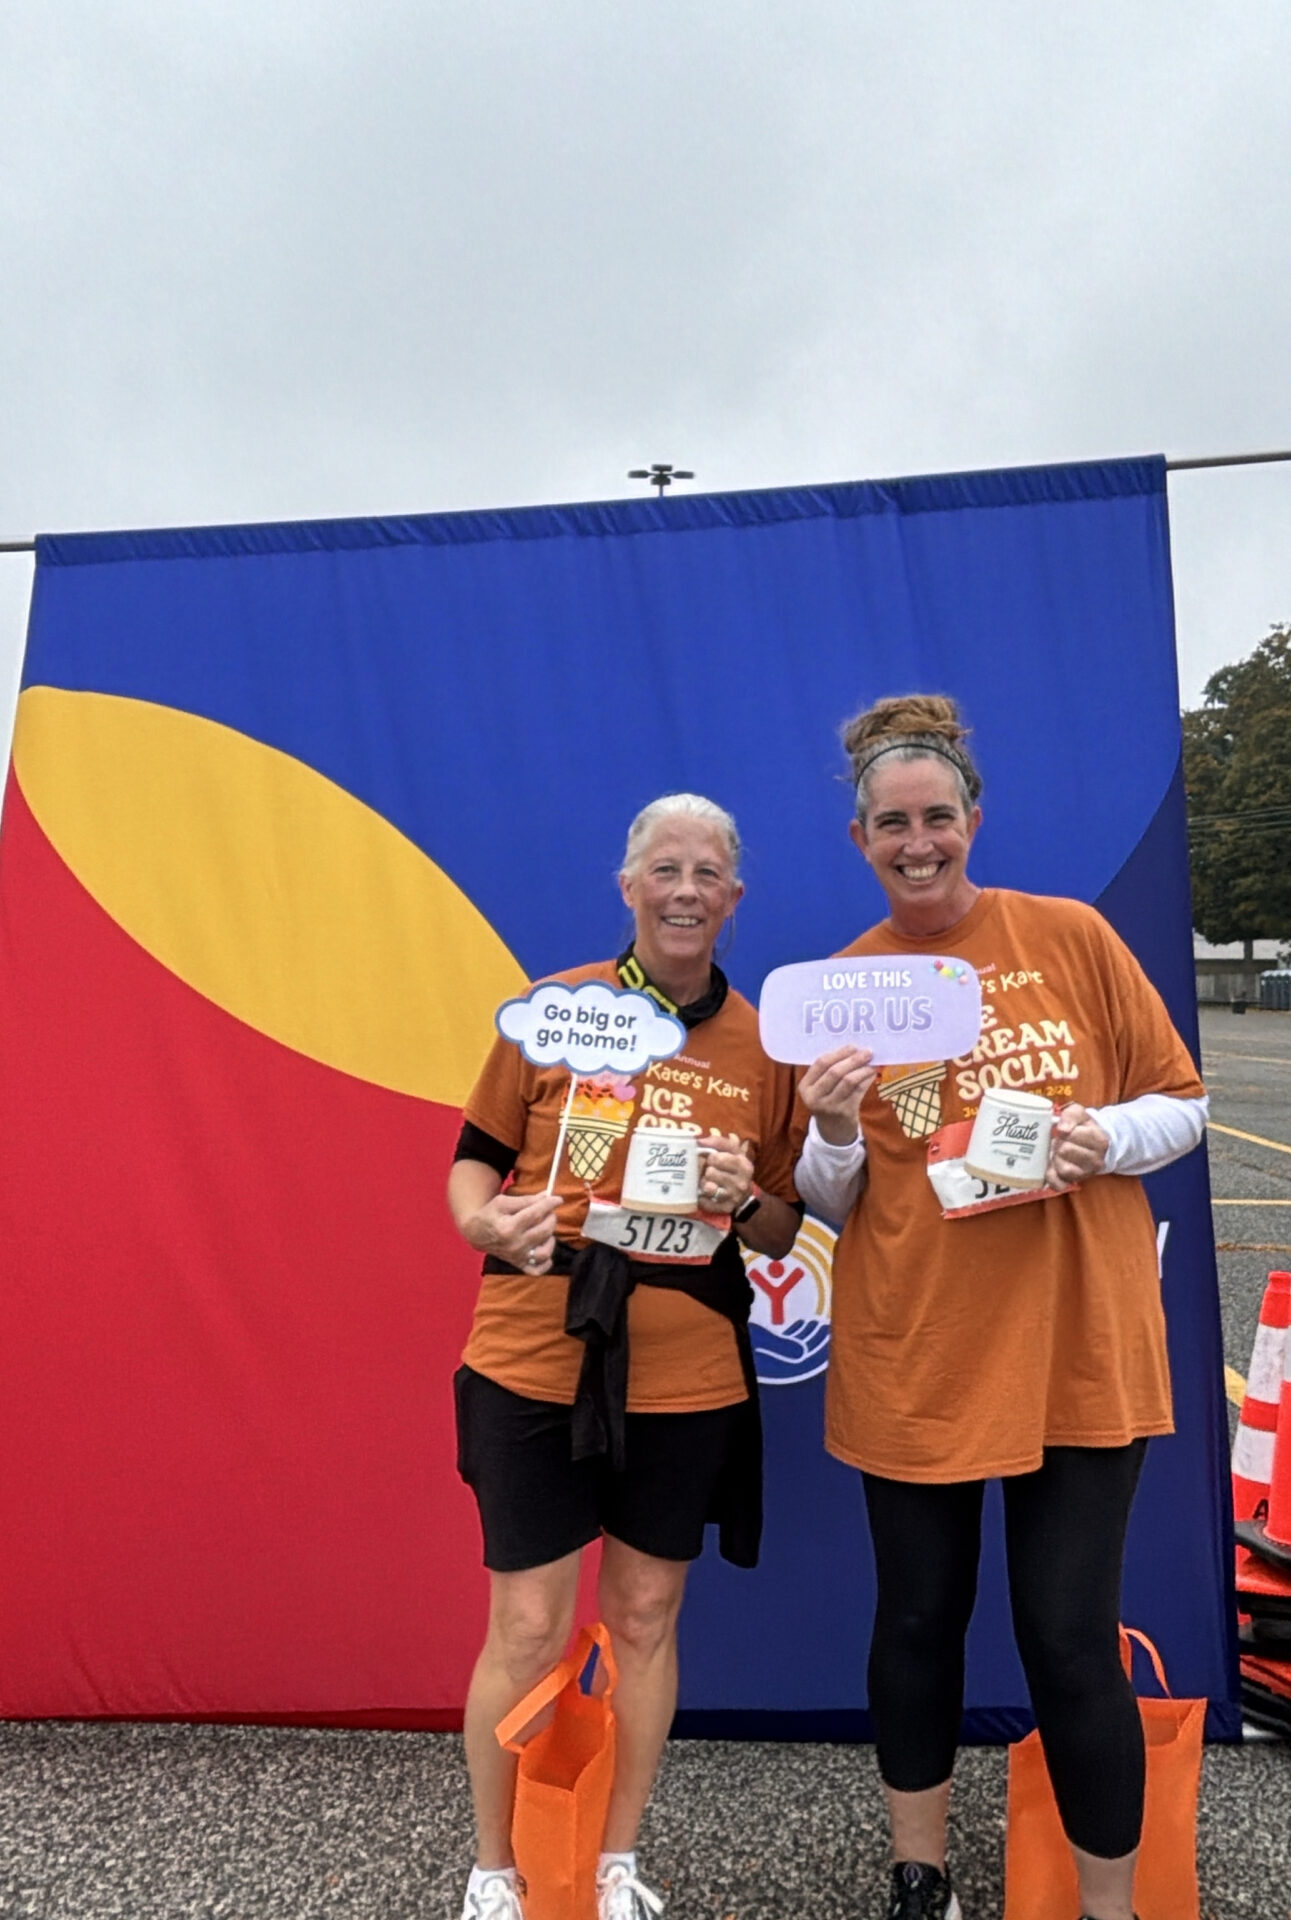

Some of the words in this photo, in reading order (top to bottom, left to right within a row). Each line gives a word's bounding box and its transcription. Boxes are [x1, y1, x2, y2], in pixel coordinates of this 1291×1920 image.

[823, 971, 867, 990] LOVE
[871, 970, 912, 988] THIS
[544, 1004, 571, 1021] Go
[576, 1006, 609, 1031] big
[614, 1014, 637, 1029] or
[803, 998, 877, 1035] FOR
[884, 996, 933, 1033] US
[536, 1028, 563, 1047] go
[567, 1027, 637, 1052] home!
[646, 1061, 703, 1089] Kate's
[706, 1076, 750, 1102] Kart
[955, 1049, 1079, 1101] SOCIAL
[640, 1083, 693, 1118] ICE
[993, 1115, 1040, 1141] Hustle
[645, 1146, 688, 1168] Hustle
[619, 1215, 694, 1254] 5123
